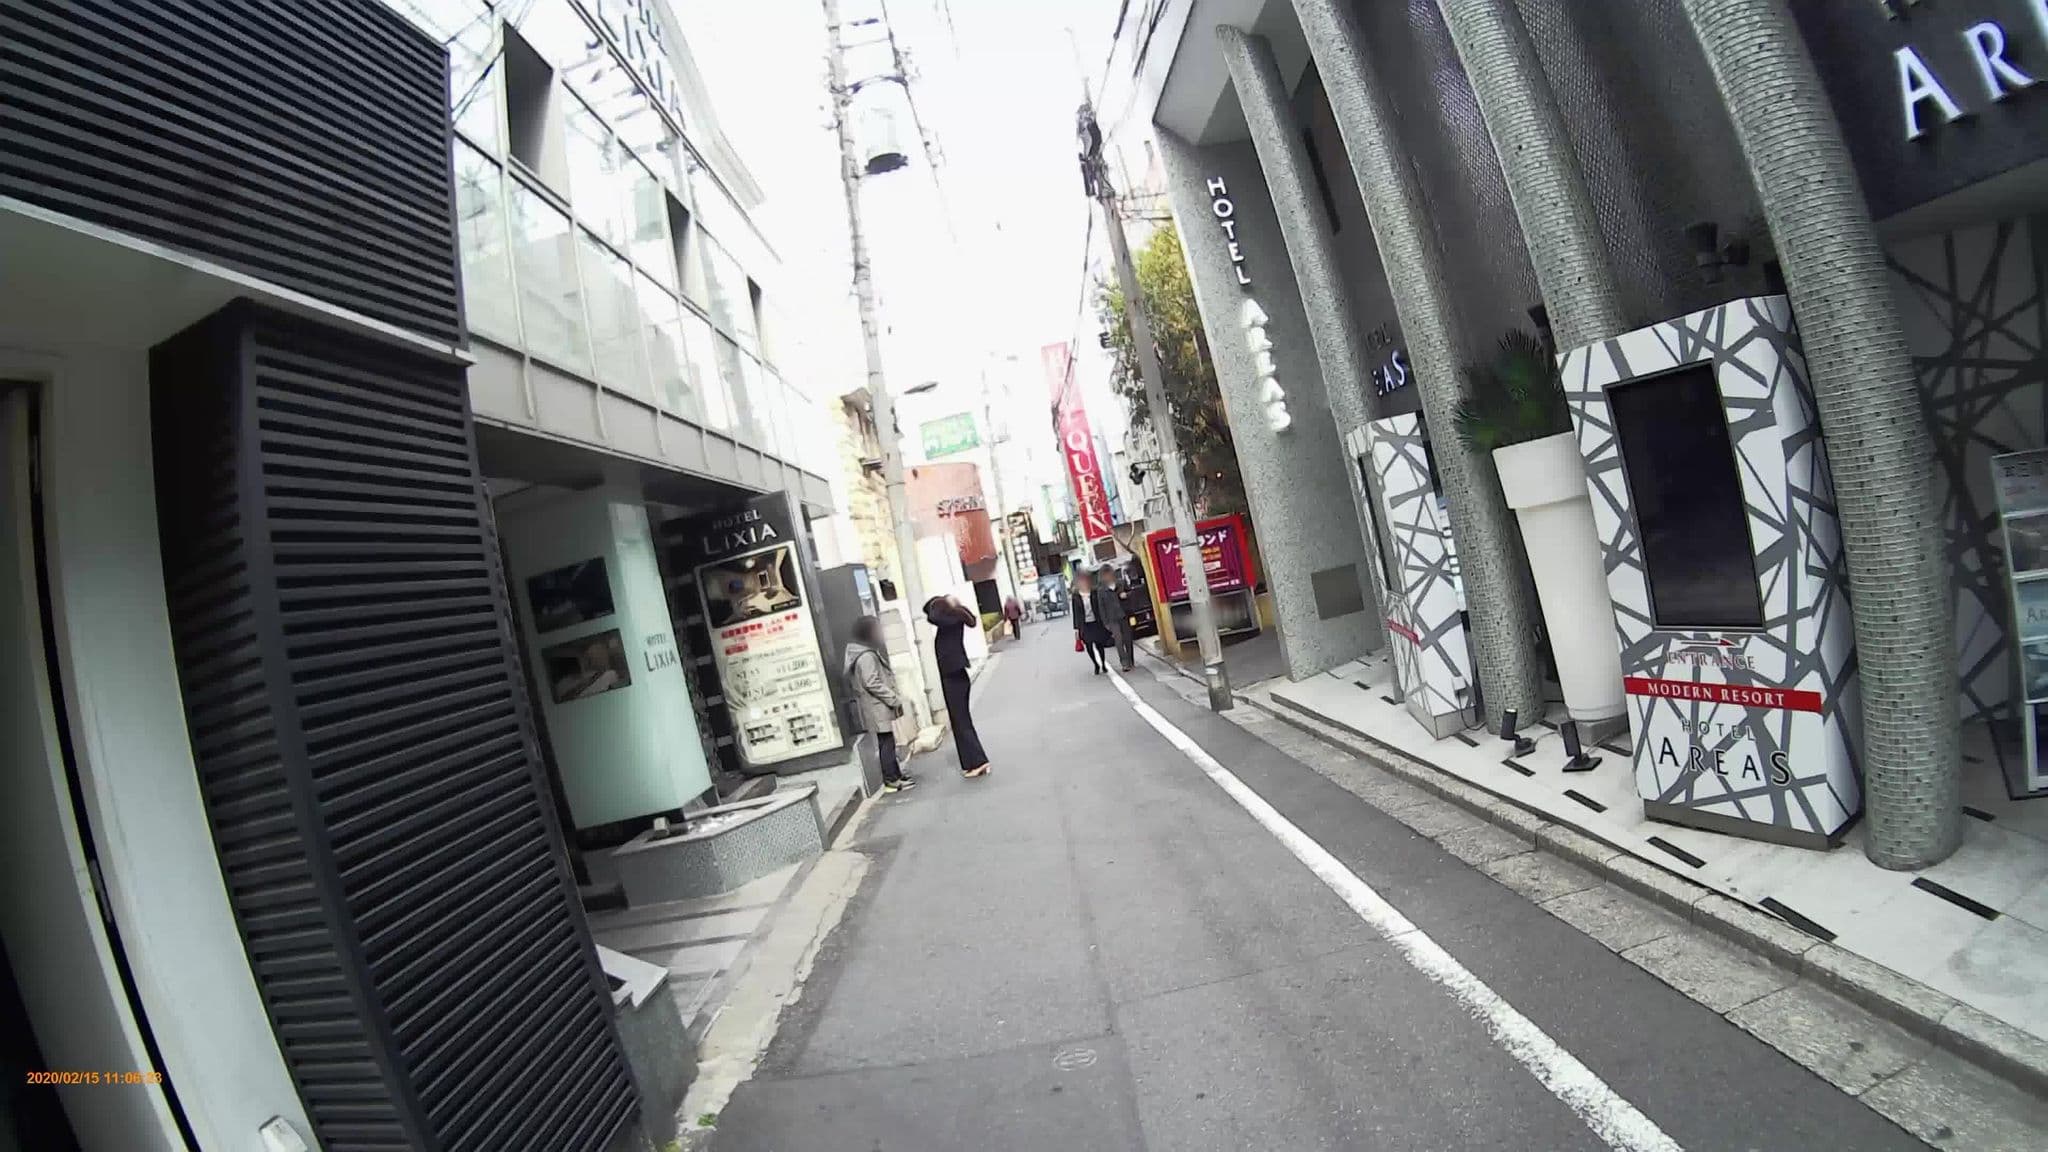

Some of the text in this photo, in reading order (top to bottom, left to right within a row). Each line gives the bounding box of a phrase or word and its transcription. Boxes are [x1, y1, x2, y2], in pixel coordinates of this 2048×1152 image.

[1206, 176, 1252, 285] HOTEL
[703, 522, 778, 556] LIXIA
[644, 650, 678, 672] LIXIA
[1666, 651, 1756, 670] ENTRANCE
[1647, 682, 1785, 707] MODERN RESORT
[1680, 718, 1757, 741] HOTEL
[1658, 737, 1790, 787] AREAS
